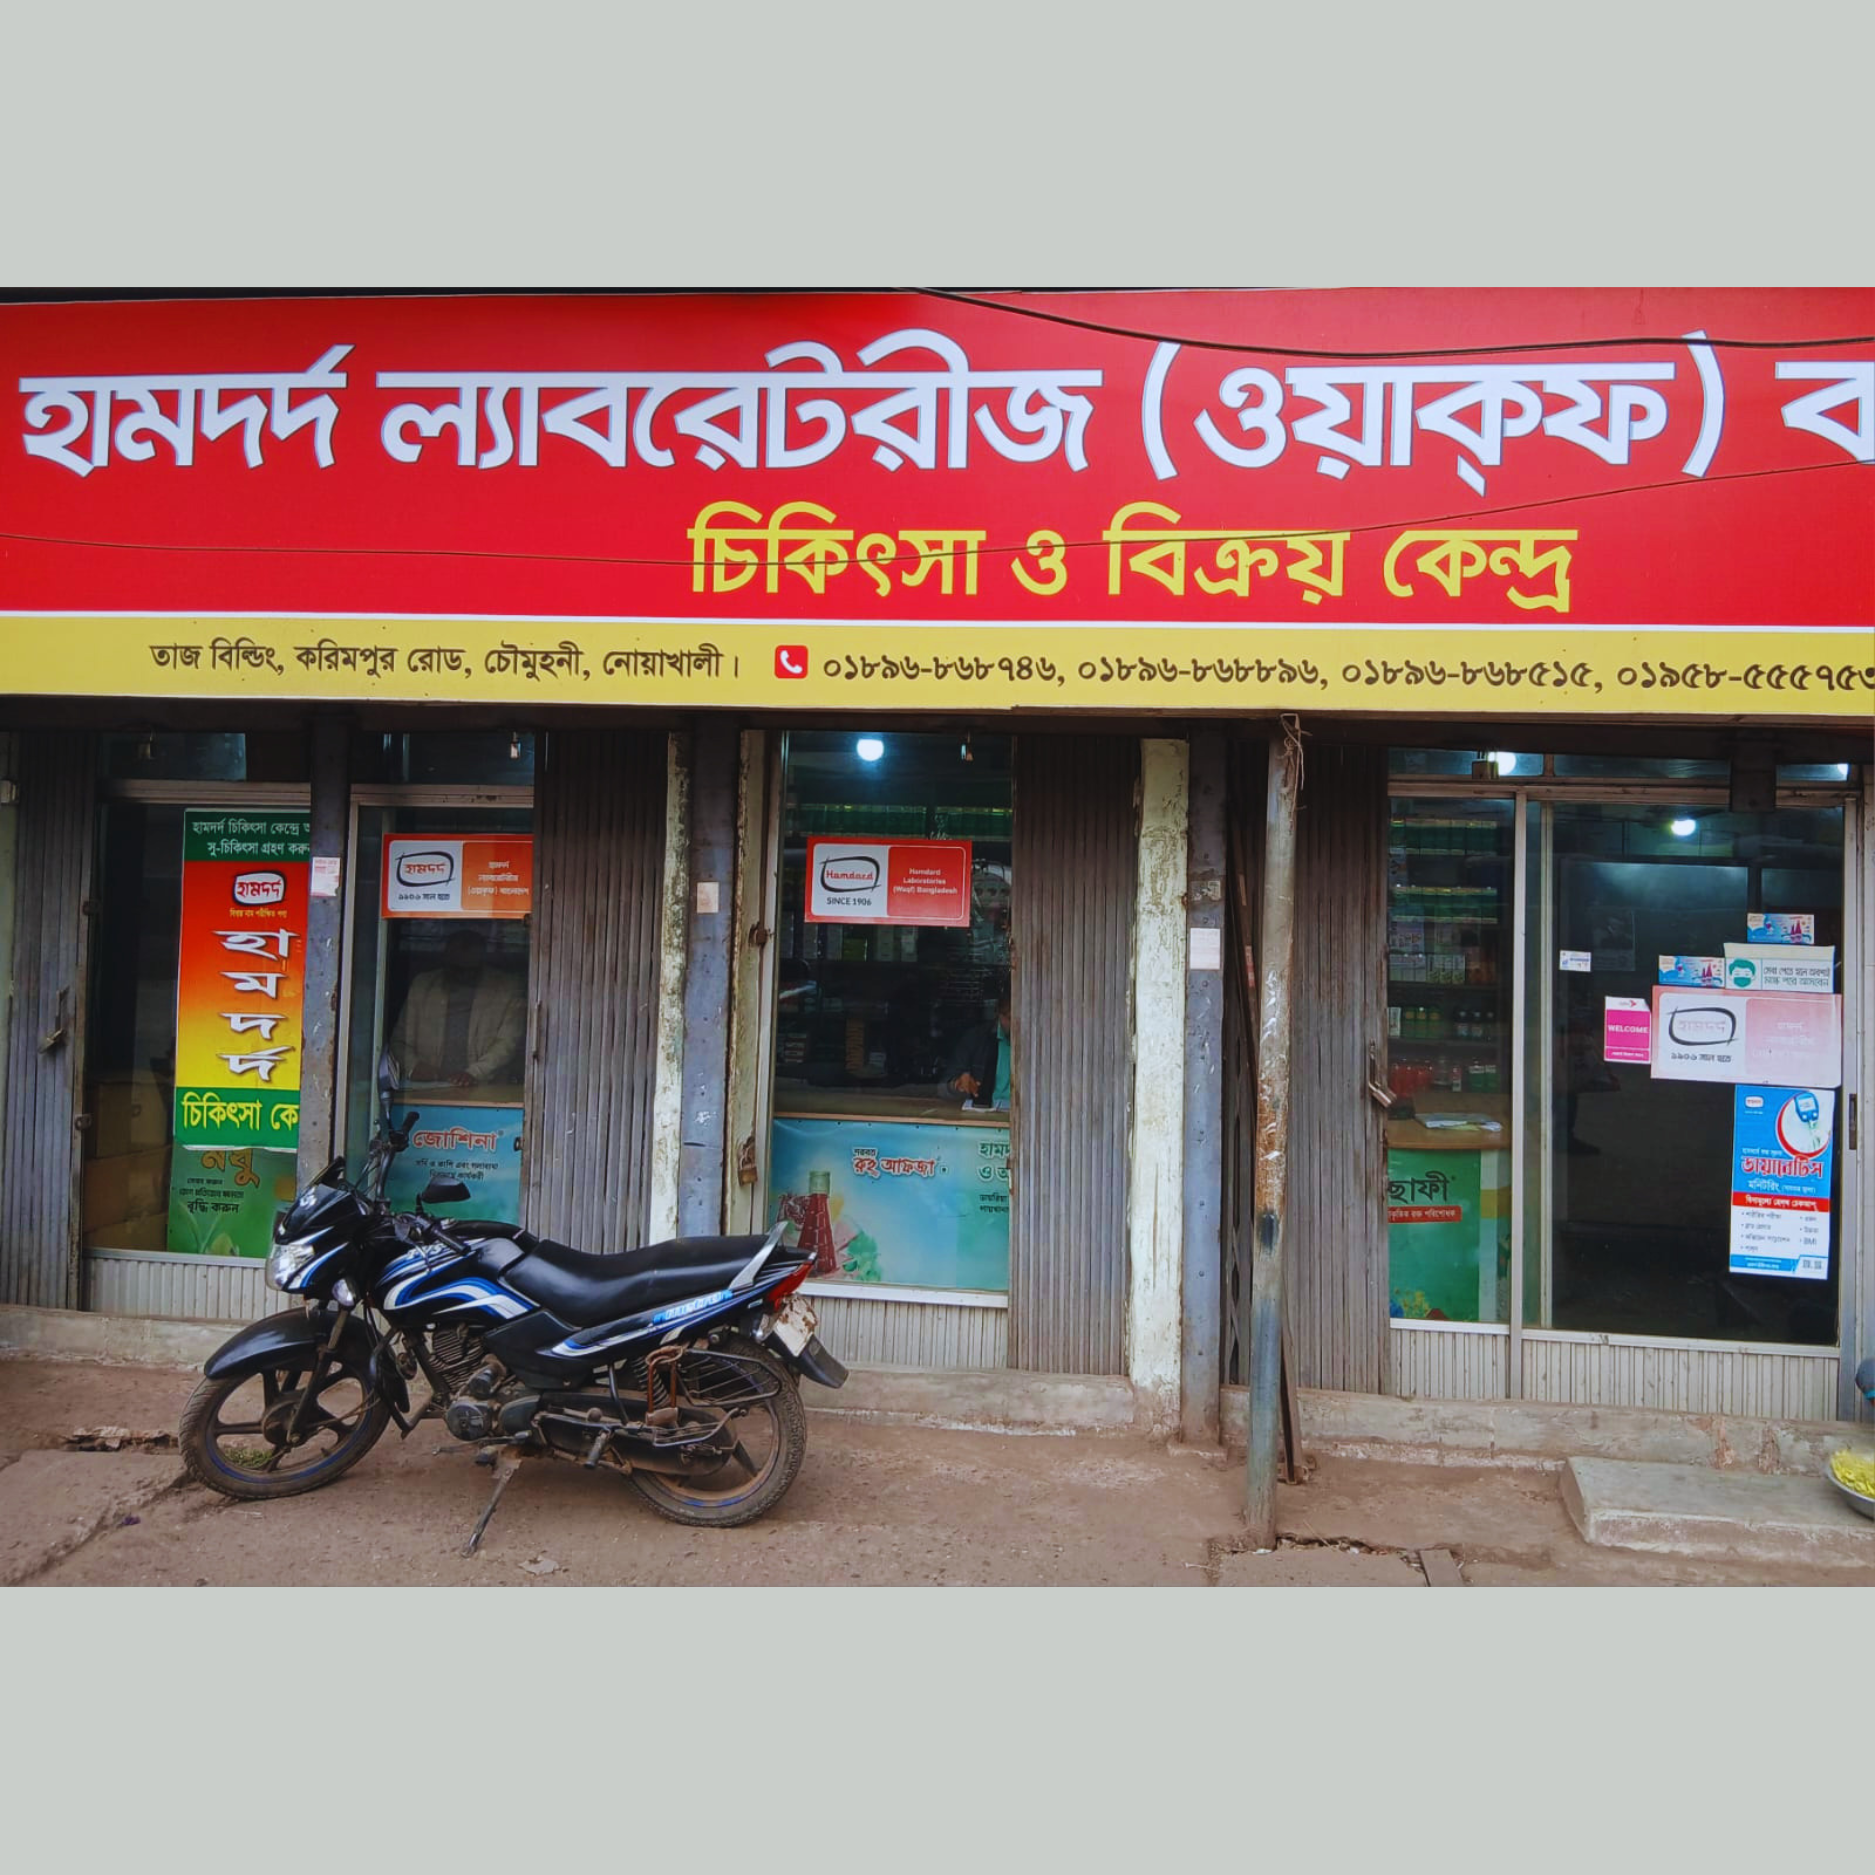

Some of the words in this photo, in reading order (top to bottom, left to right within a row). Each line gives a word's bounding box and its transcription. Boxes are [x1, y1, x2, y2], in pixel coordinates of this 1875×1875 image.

[19, 345, 354, 477] হামদর্দ
[377, 329, 1103, 472] ল্যাবরেটরীজ
[687, 501, 987, 597] চিকিৎসা
[1011, 529, 1067, 597] ও
[1101, 501, 1351, 605] বিক্রয়
[1383, 529, 1579, 614] কেন্দ্র
[149, 645, 200, 670] তাজ
[210, 637, 284, 674] বিল্ডিং,
[294, 638, 397, 677] করিমপুর
[407, 648, 472, 679] রোড,
[484, 640, 590, 682] চৌমুহনী,
[823, 655, 1065, 686] ০১৮৯৬-৮৬৮৭৪৬,
[1078, 656, 1328, 689] ০১৮৯৬-৮৬৮৮৯৬,
[1342, 659, 1602, 692] ০১৮৯৬-৮৬৮৫১৫,
[191, 818, 227, 835] হামদর্দ
[228, 817, 267, 835] চিকিৎসা
[826, 868, 874, 881] Hamdard
[903, 876, 946, 885] Laboratories
[909, 867, 941, 876] Hamdard
[236, 879, 282, 898] হামদর্দ
[916, 886, 957, 896] Bangladesh
[826, 896, 851, 906] SINCE
[852, 897, 872, 906] 1906
[1608, 1024, 1649, 1034] WELCOME
[182, 1091, 263, 1131] চিকিৎসা
